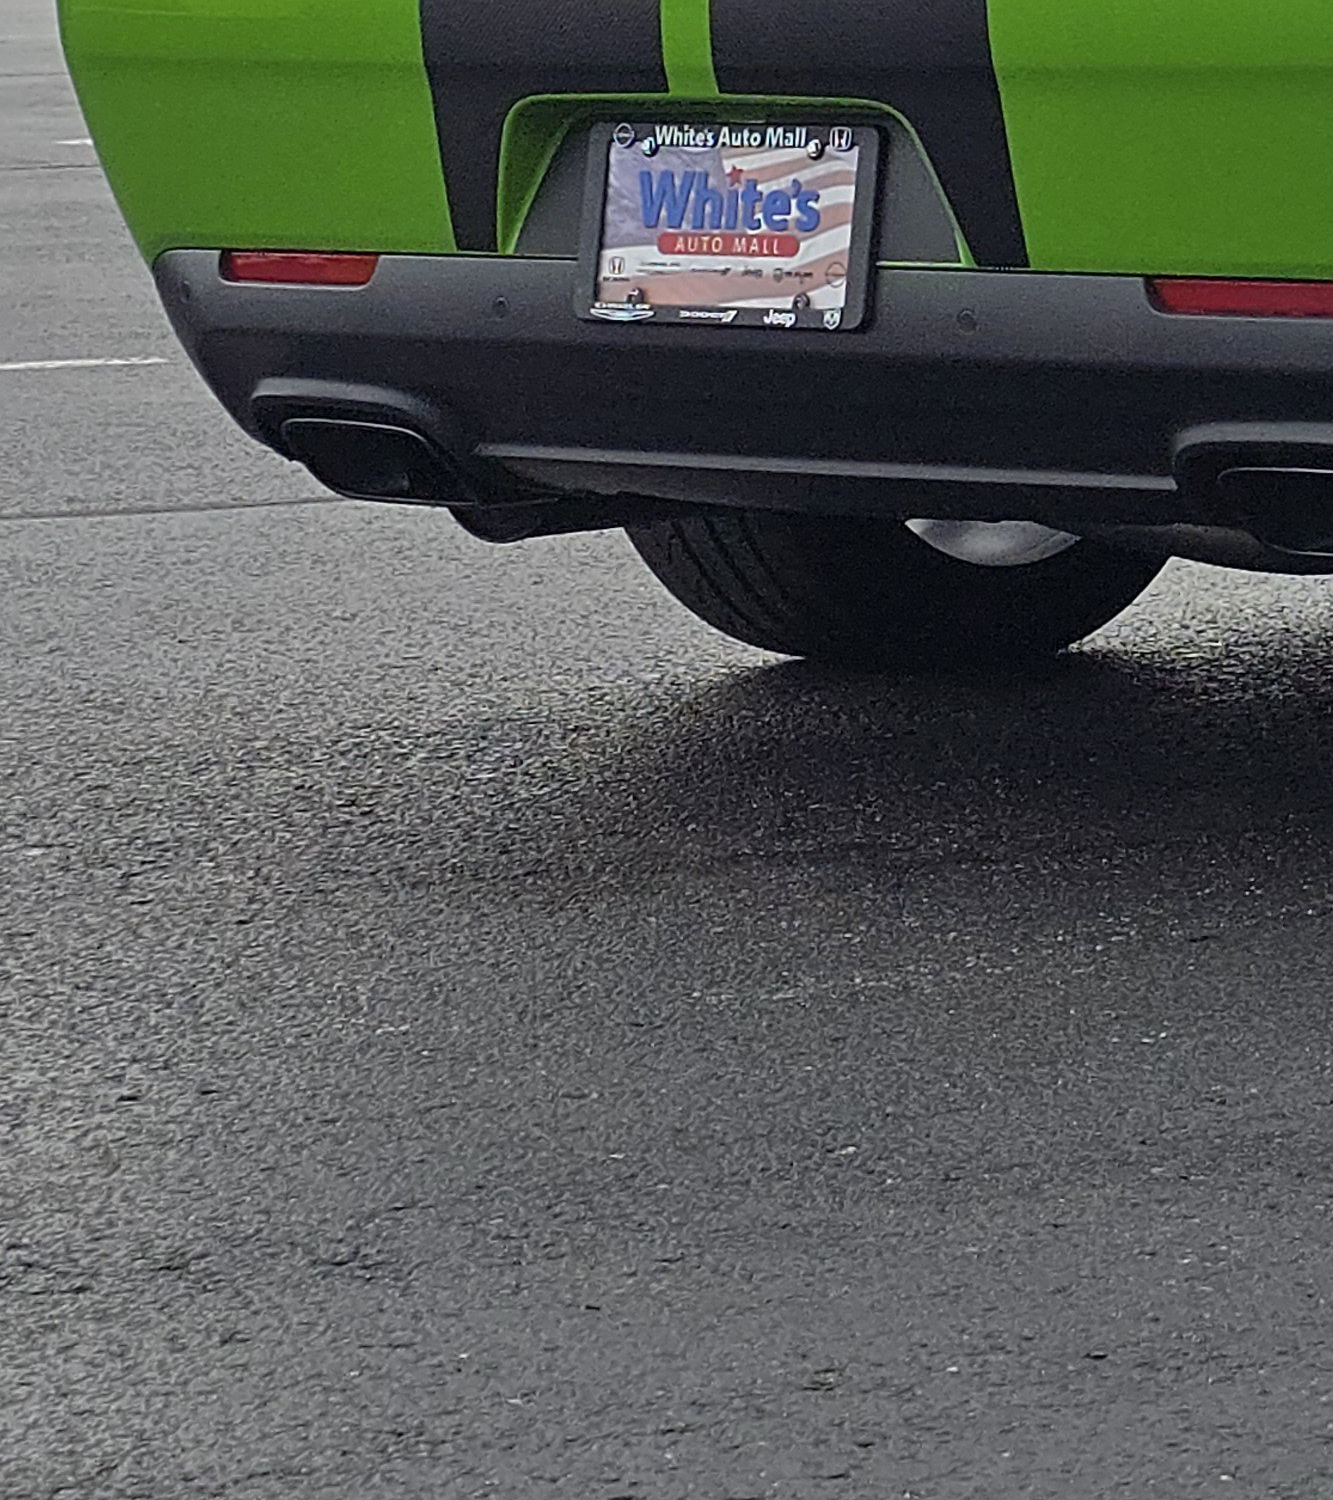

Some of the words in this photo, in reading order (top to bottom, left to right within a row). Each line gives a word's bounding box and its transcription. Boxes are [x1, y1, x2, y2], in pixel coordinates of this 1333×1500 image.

[655, 124, 714, 147] White's
[717, 126, 761, 147] Auto
[765, 127, 807, 148] Mall
[639, 167, 821, 232] White's
[675, 236, 721, 253] AUTO
[732, 237, 780, 255] MALL
[763, 308, 796, 328] Jeep
